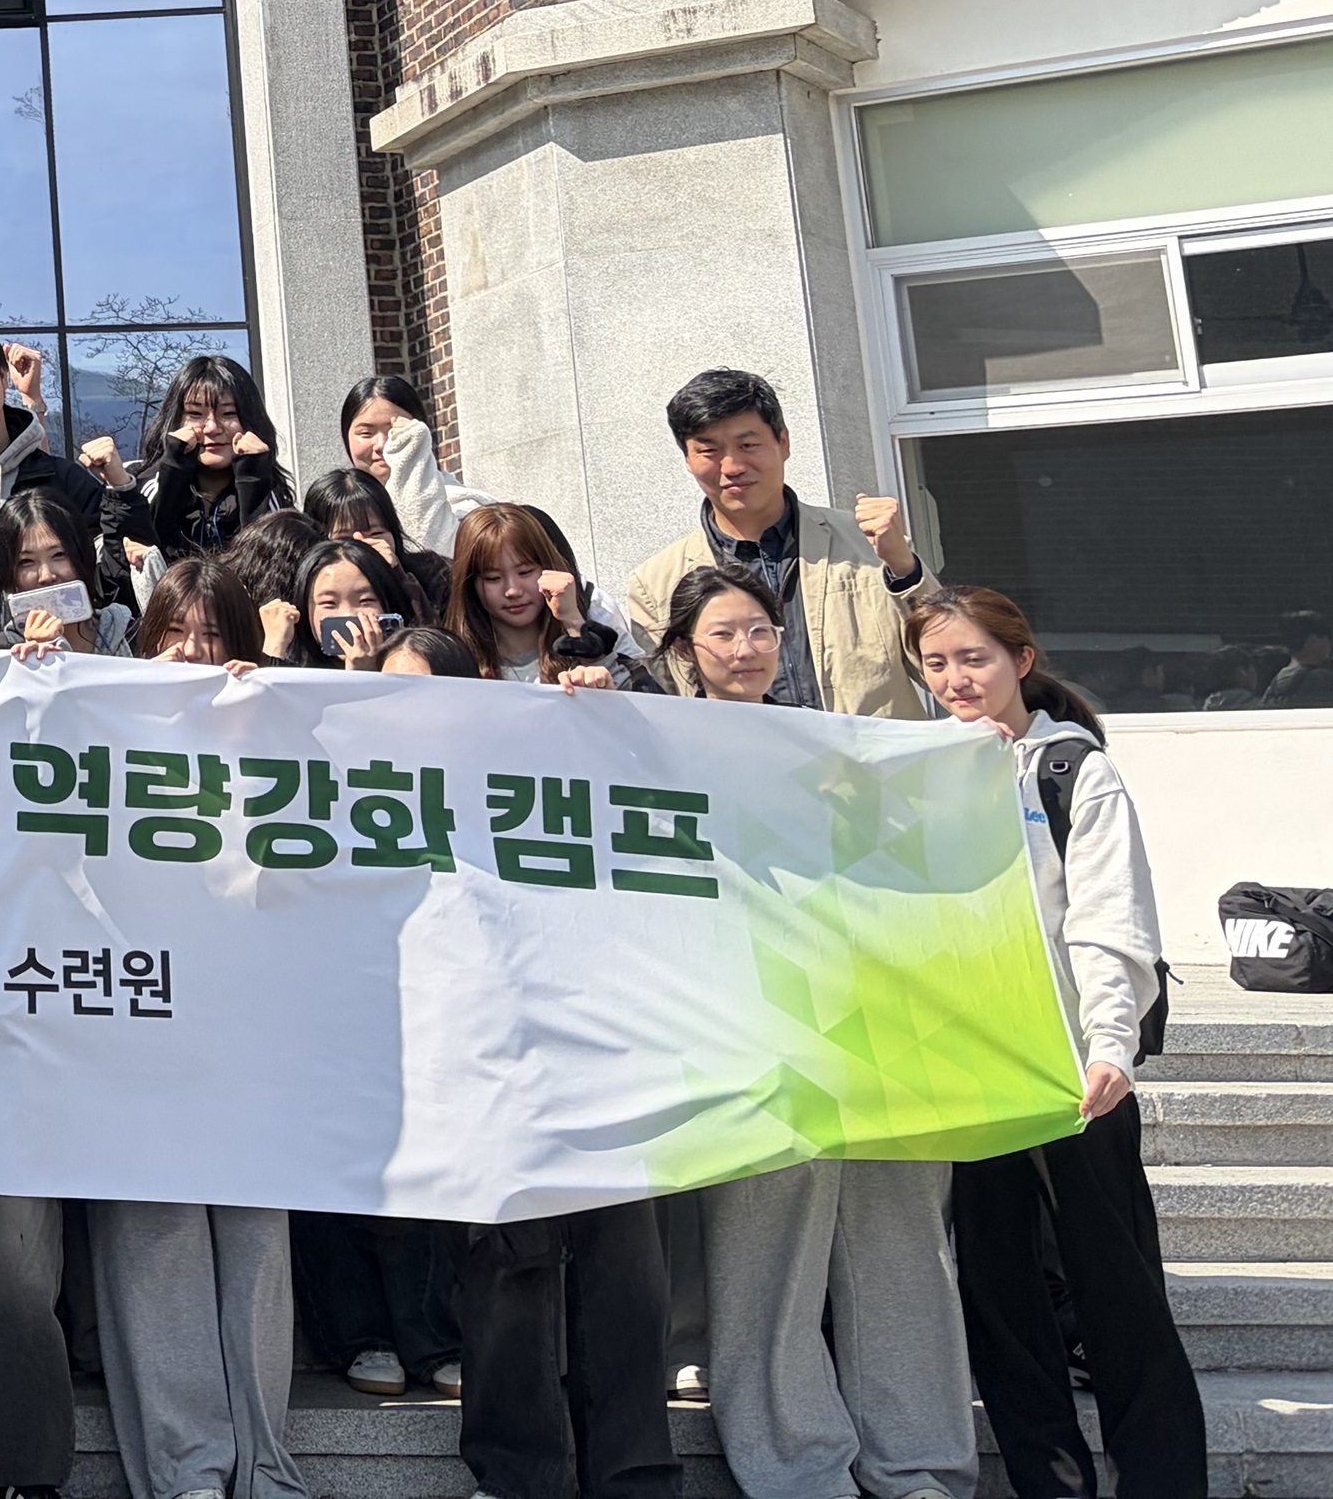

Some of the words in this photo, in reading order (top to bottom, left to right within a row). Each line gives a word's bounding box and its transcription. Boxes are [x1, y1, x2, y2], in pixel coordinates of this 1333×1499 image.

[485, 772, 720, 900] 캠프
[1023, 807, 1047, 824] Lee
[1224, 917, 1296, 959] NIKE
[2, 946, 174, 1020] 수련원
